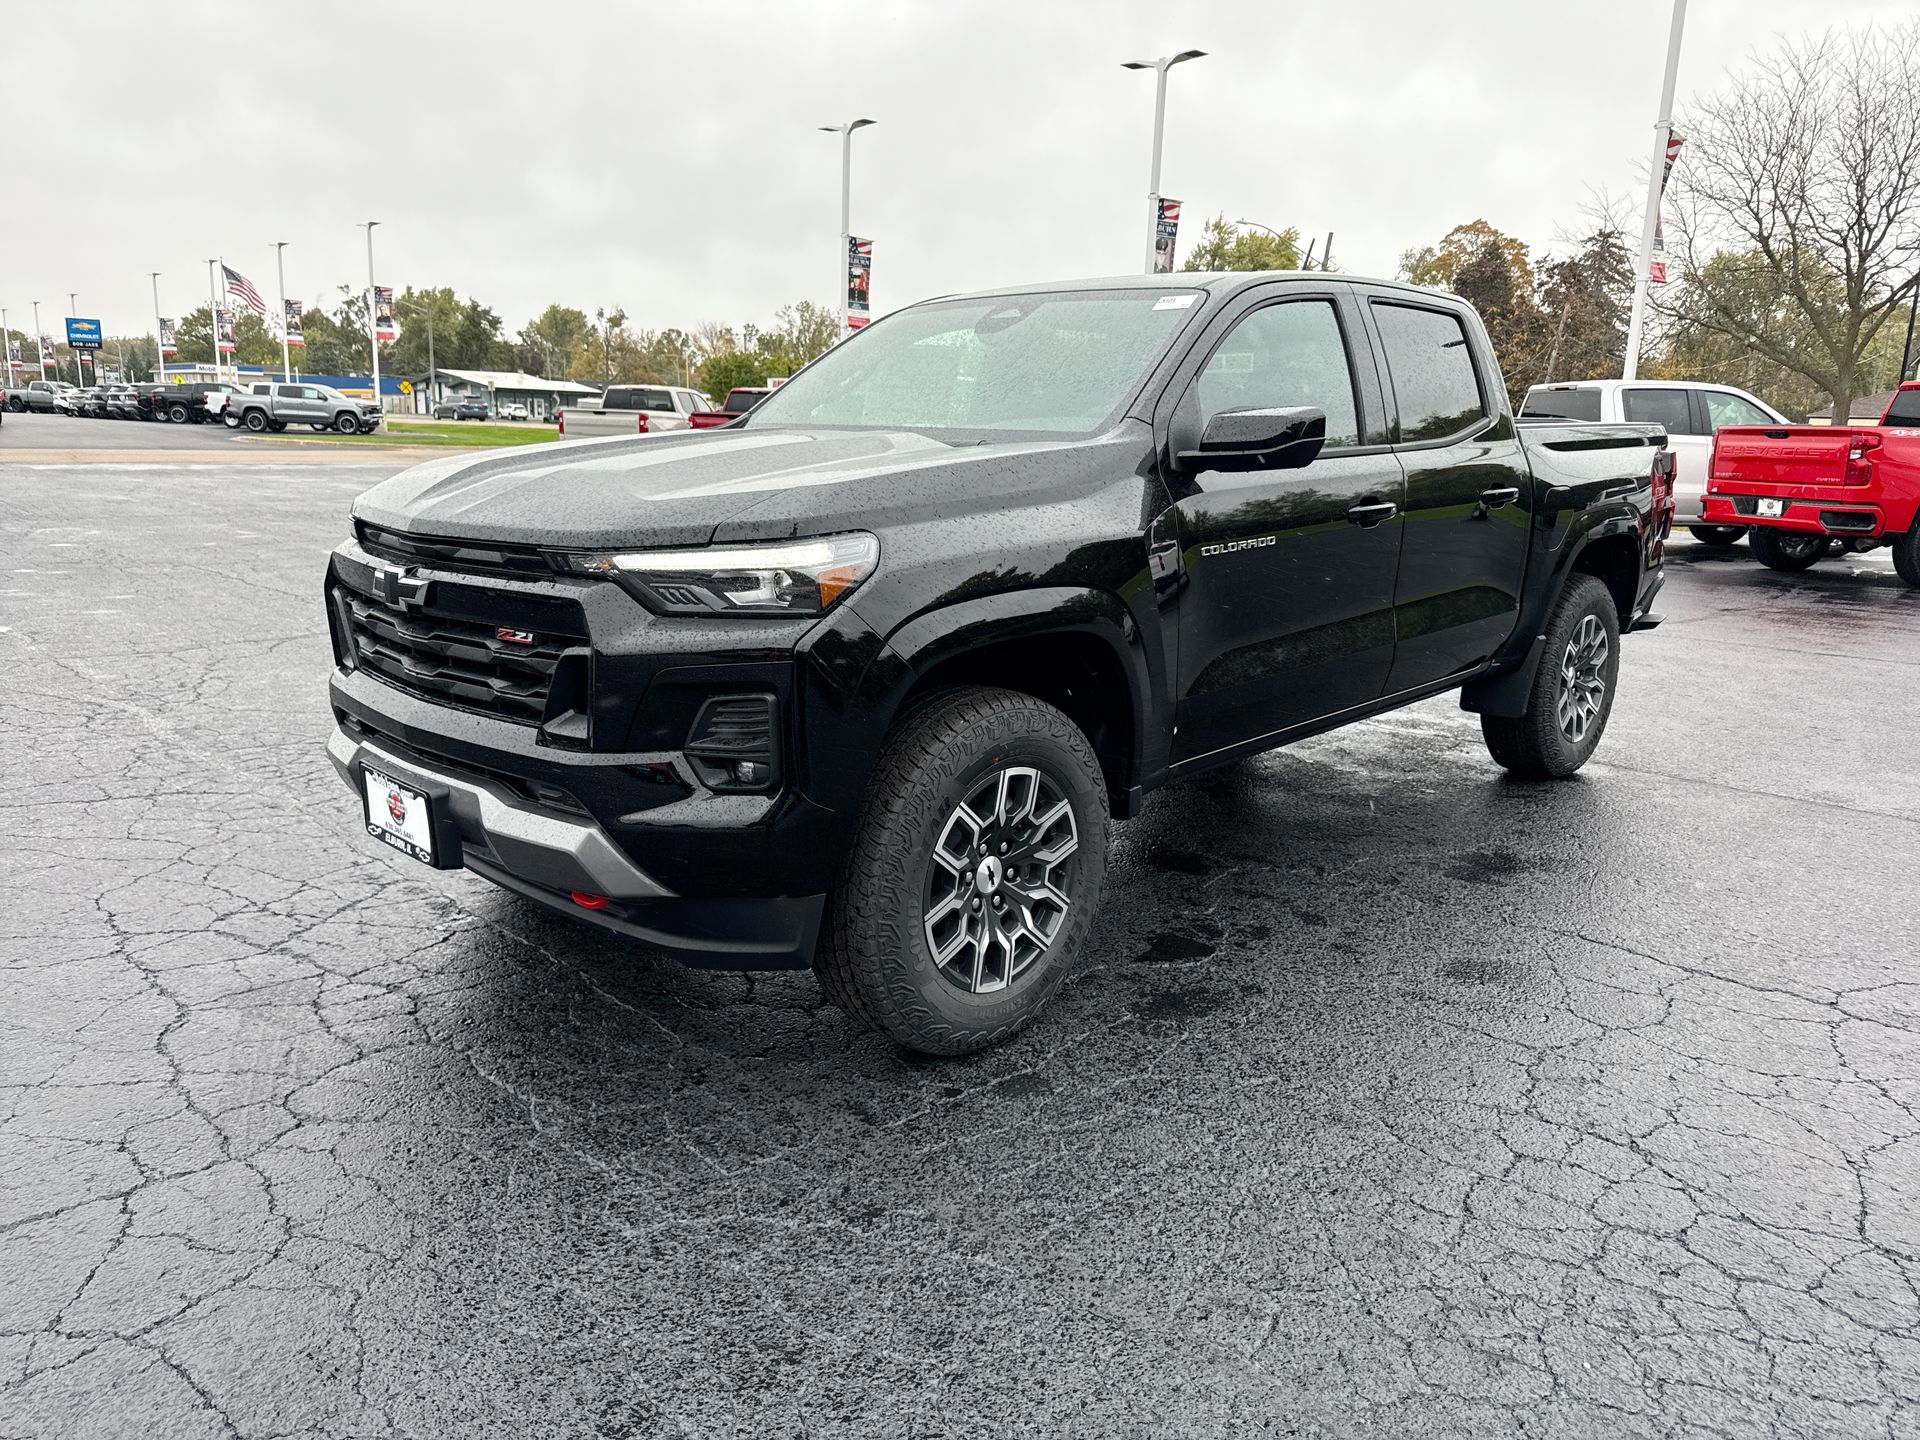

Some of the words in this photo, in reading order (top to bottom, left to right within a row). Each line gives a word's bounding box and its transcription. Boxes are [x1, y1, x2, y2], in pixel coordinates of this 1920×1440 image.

[1720, 446, 1839, 458] CHEVROLET
[1200, 535, 1277, 557] COLORADO
[496, 627, 534, 645] Z71
